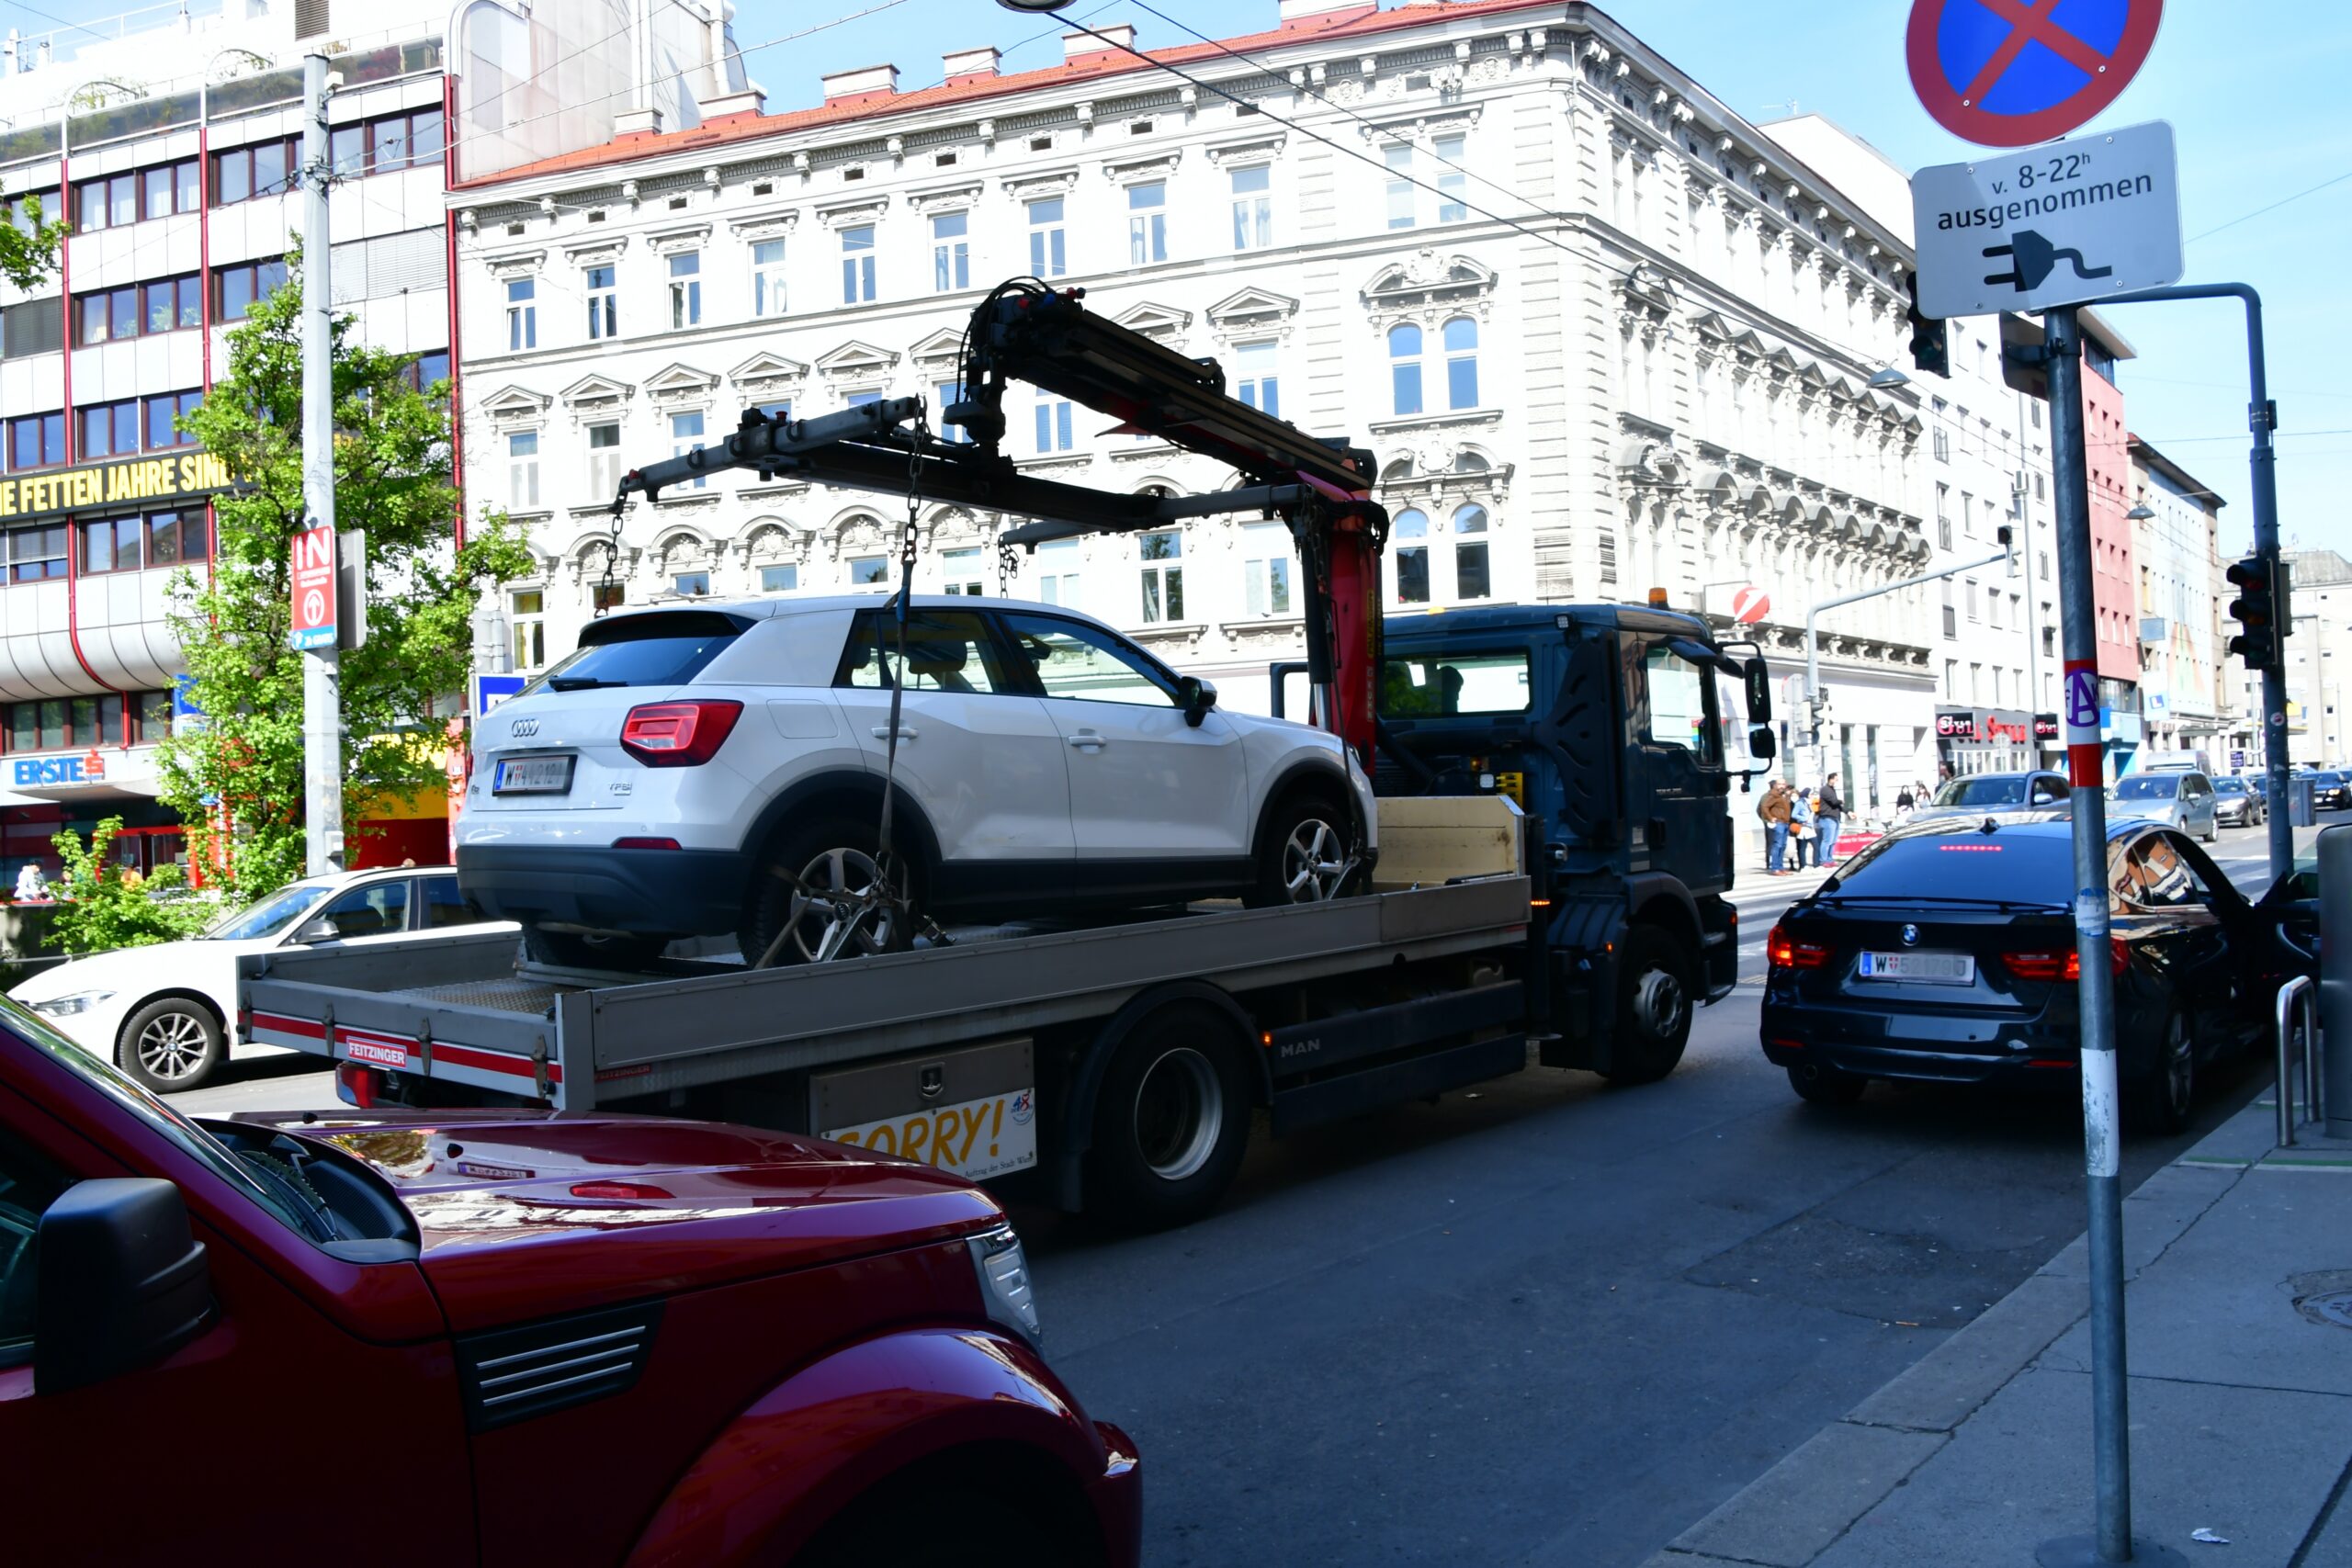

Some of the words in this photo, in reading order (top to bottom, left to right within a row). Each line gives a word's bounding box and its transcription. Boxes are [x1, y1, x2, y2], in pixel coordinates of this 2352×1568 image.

[1991, 181, 2007, 195] v.
[2018, 152, 2091, 189] 8-22h
[1937, 173, 2153, 231] ausgenommen
[19, 468, 103, 514] FETTEN
[107, 457, 177, 502] JAHRE
[296, 528, 332, 570] IN
[14, 757, 84, 786] ERSTE
[1874, 956, 1887, 974] W
[347, 1041, 406, 1066] FEITZINGER
[1280, 1038, 1320, 1058] MAN
